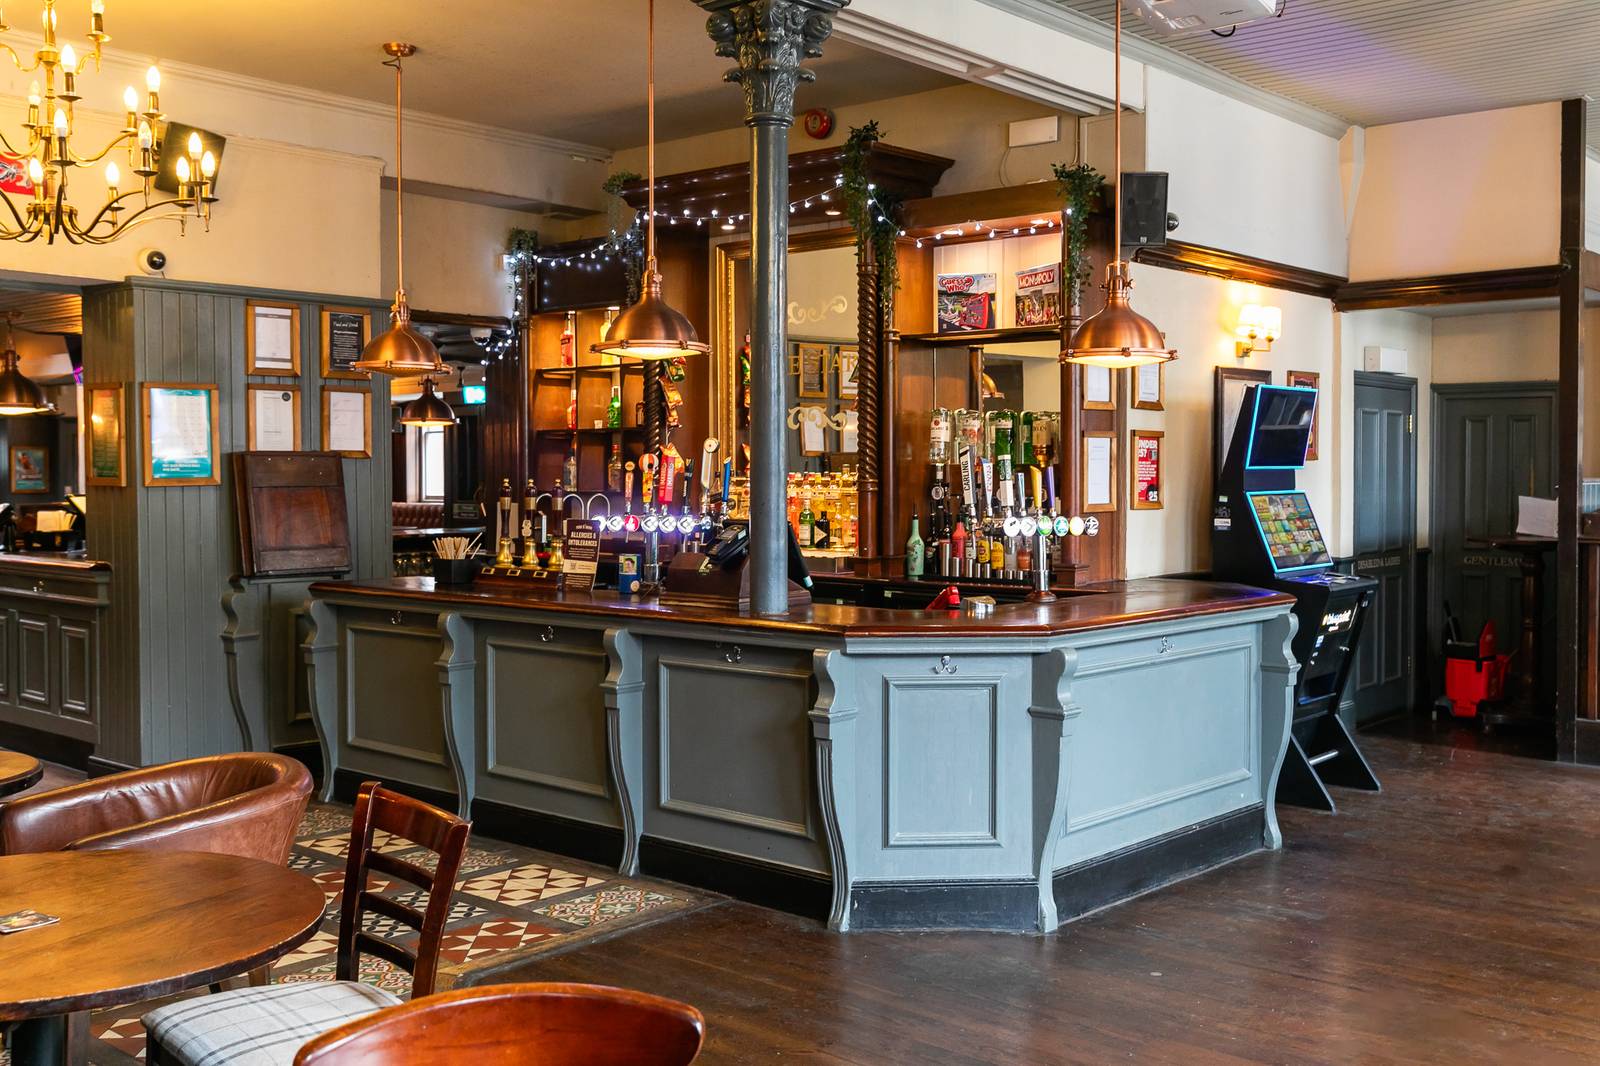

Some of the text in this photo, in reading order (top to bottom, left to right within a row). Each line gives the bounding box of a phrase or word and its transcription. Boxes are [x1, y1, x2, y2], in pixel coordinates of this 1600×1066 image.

[962, 460, 971, 491] CARLING
[1148, 490, 1158, 502] 25
[568, 539, 597, 547] INTOLERANCES
